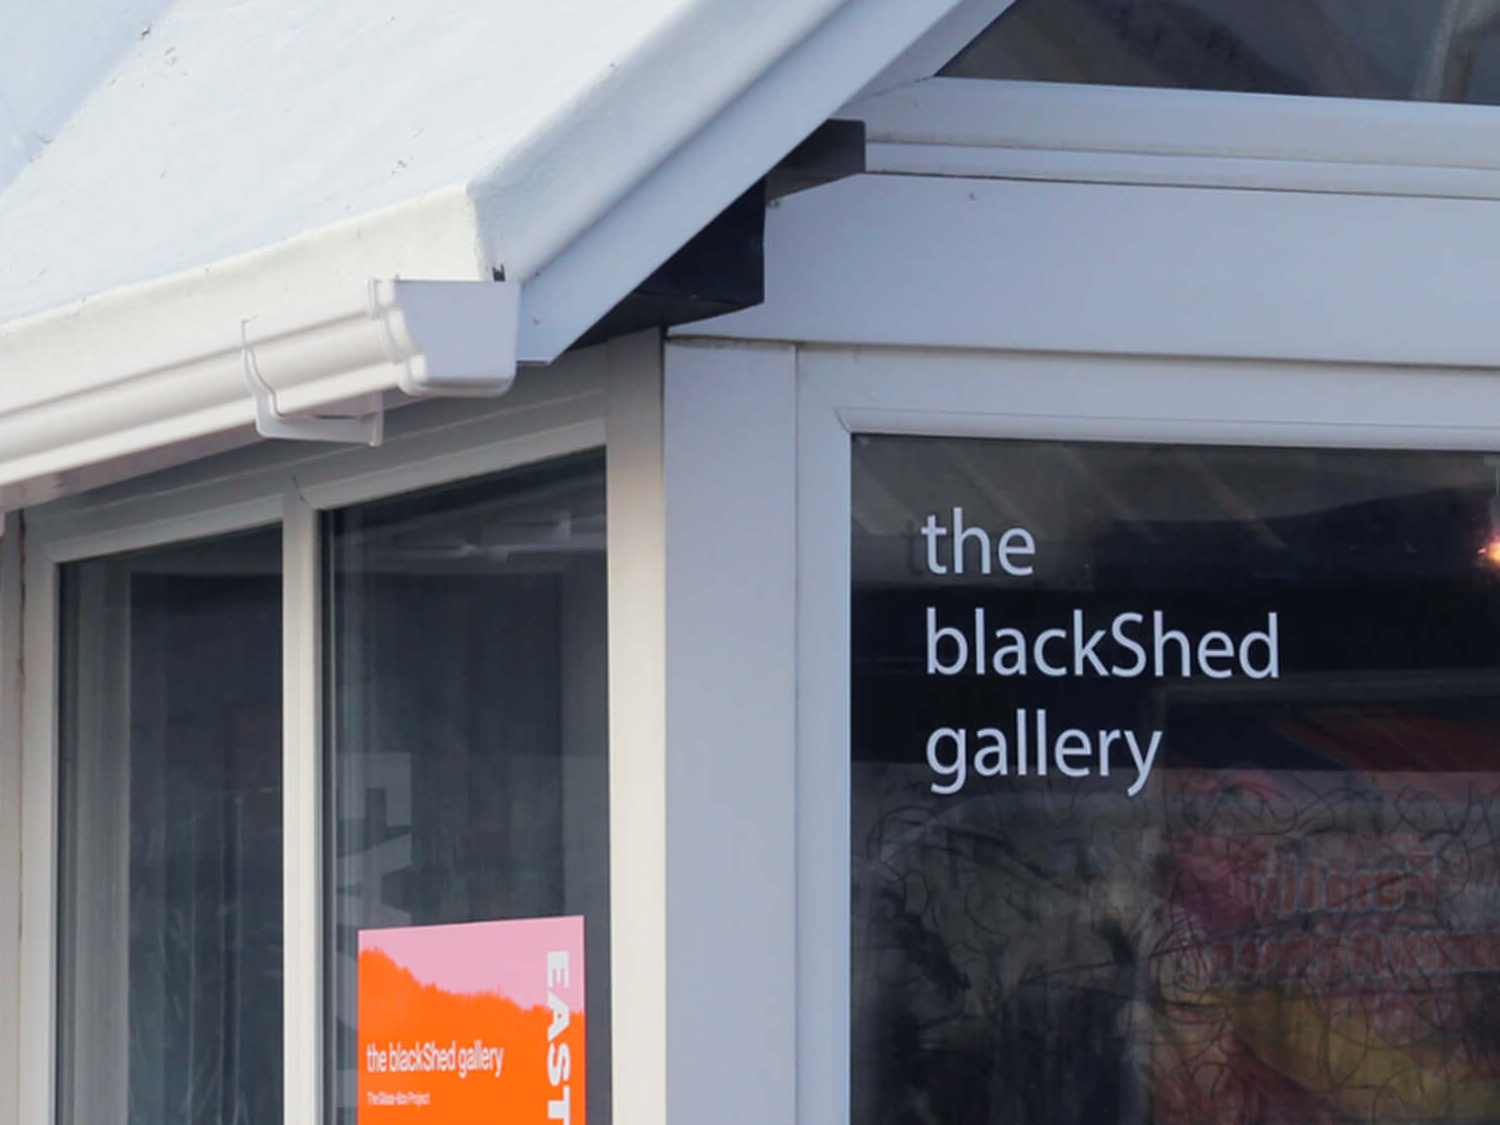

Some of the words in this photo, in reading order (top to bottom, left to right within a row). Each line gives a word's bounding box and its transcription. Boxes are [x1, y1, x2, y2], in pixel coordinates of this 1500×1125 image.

[921, 507, 1036, 575] the
[926, 607, 1280, 679] blackShed
[926, 708, 1163, 797] gallery
[366, 1041, 387, 1073] the
[389, 1040, 457, 1072] blackShed
[458, 1039, 503, 1079] gallery
[547, 950, 571, 1125] EAST
